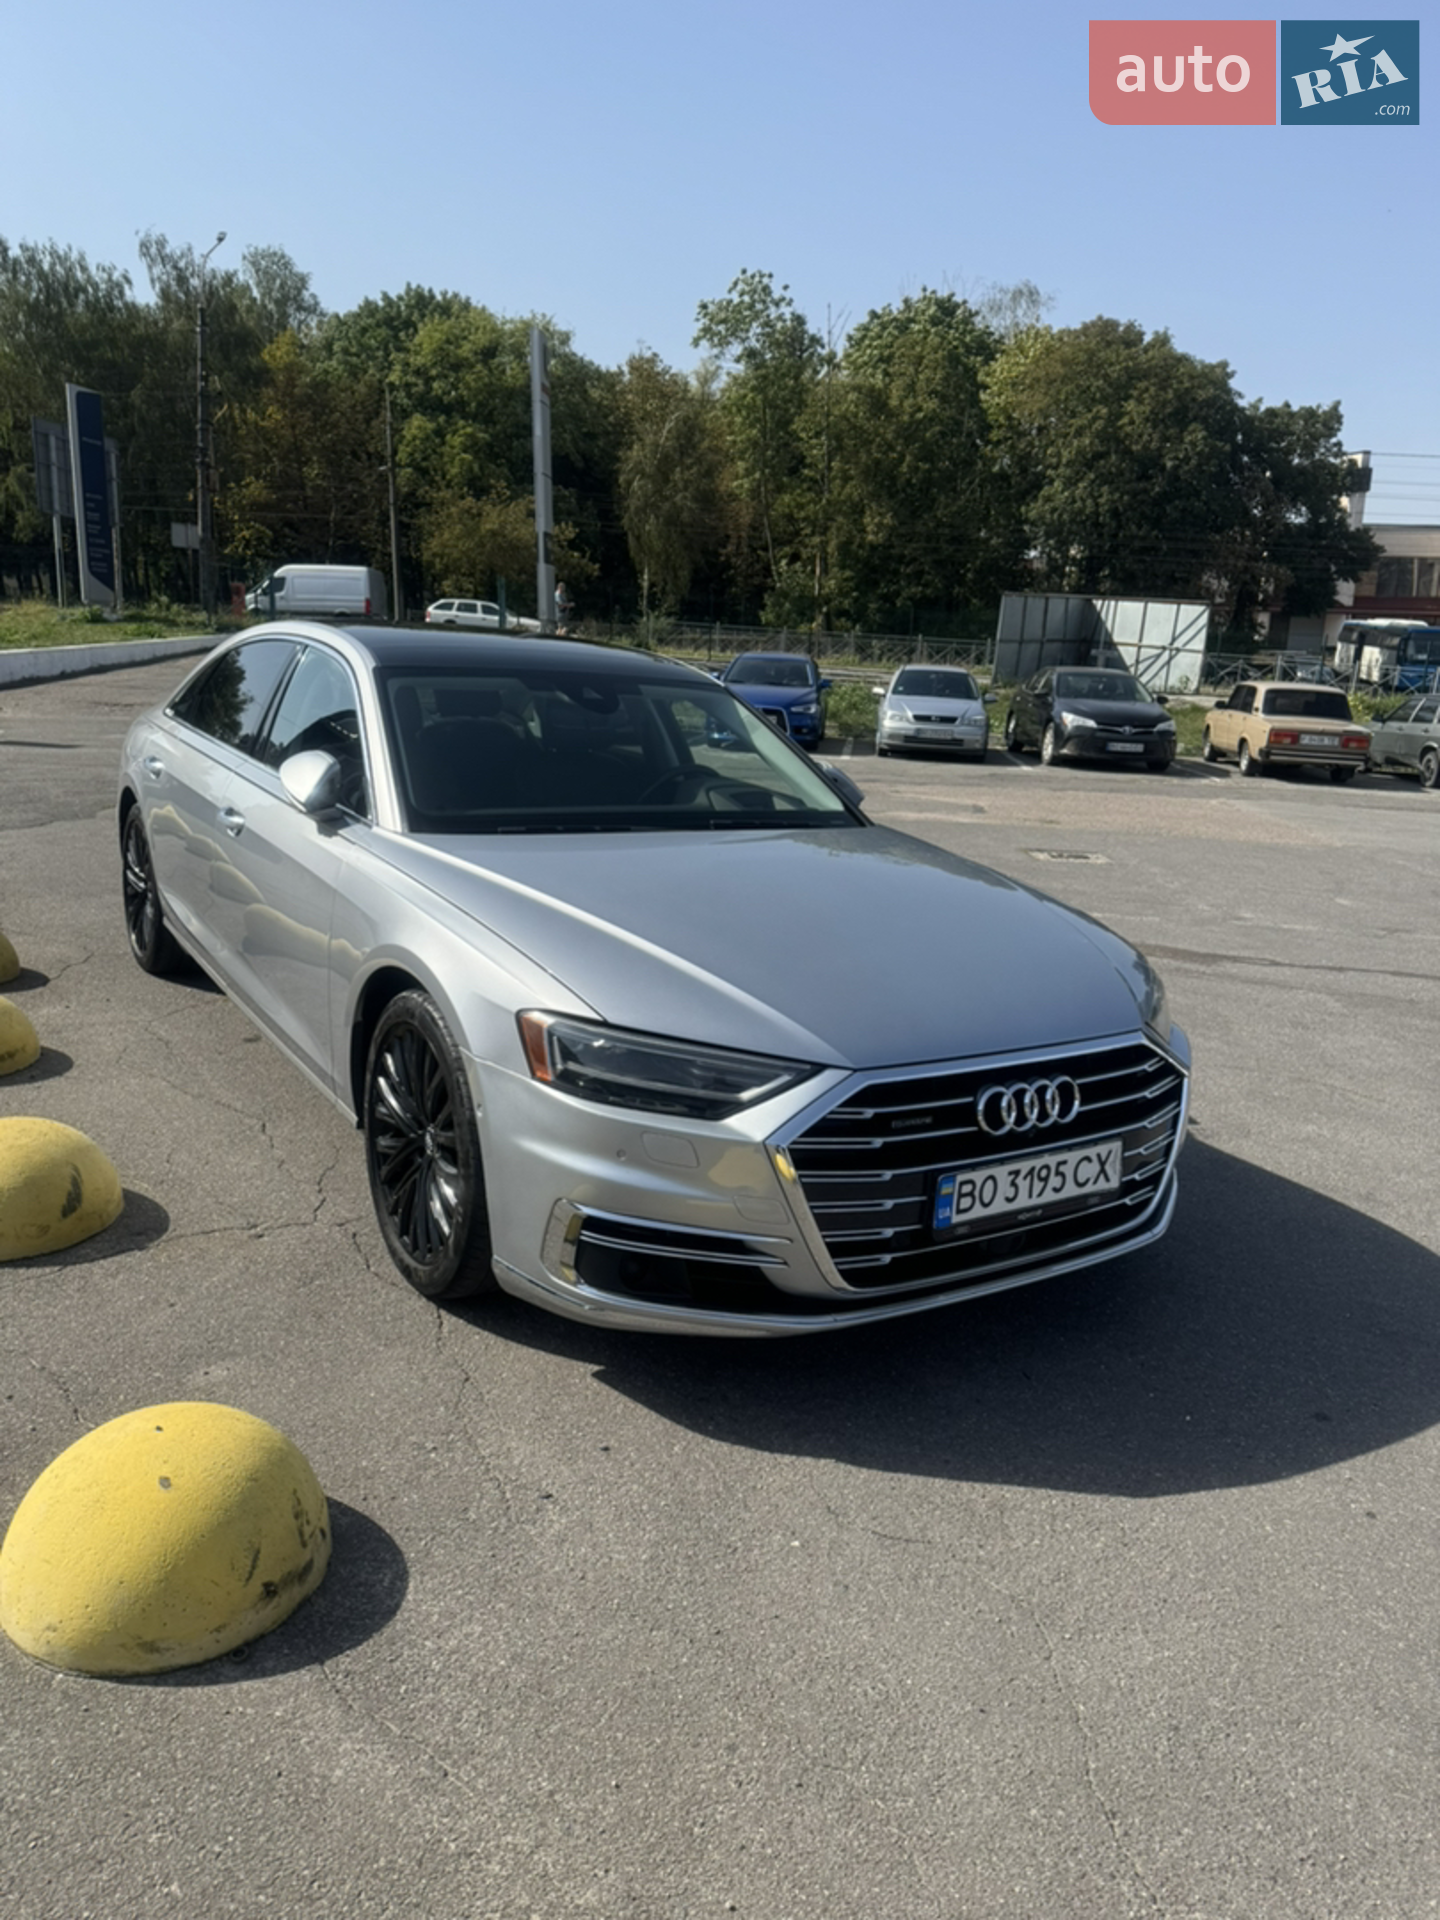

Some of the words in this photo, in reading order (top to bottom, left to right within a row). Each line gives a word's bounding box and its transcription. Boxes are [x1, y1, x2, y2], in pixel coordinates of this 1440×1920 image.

[956, 1174, 998, 1216] BO
[1004, 1159, 1069, 1204] 3195
[1073, 1149, 1113, 1188] CX
